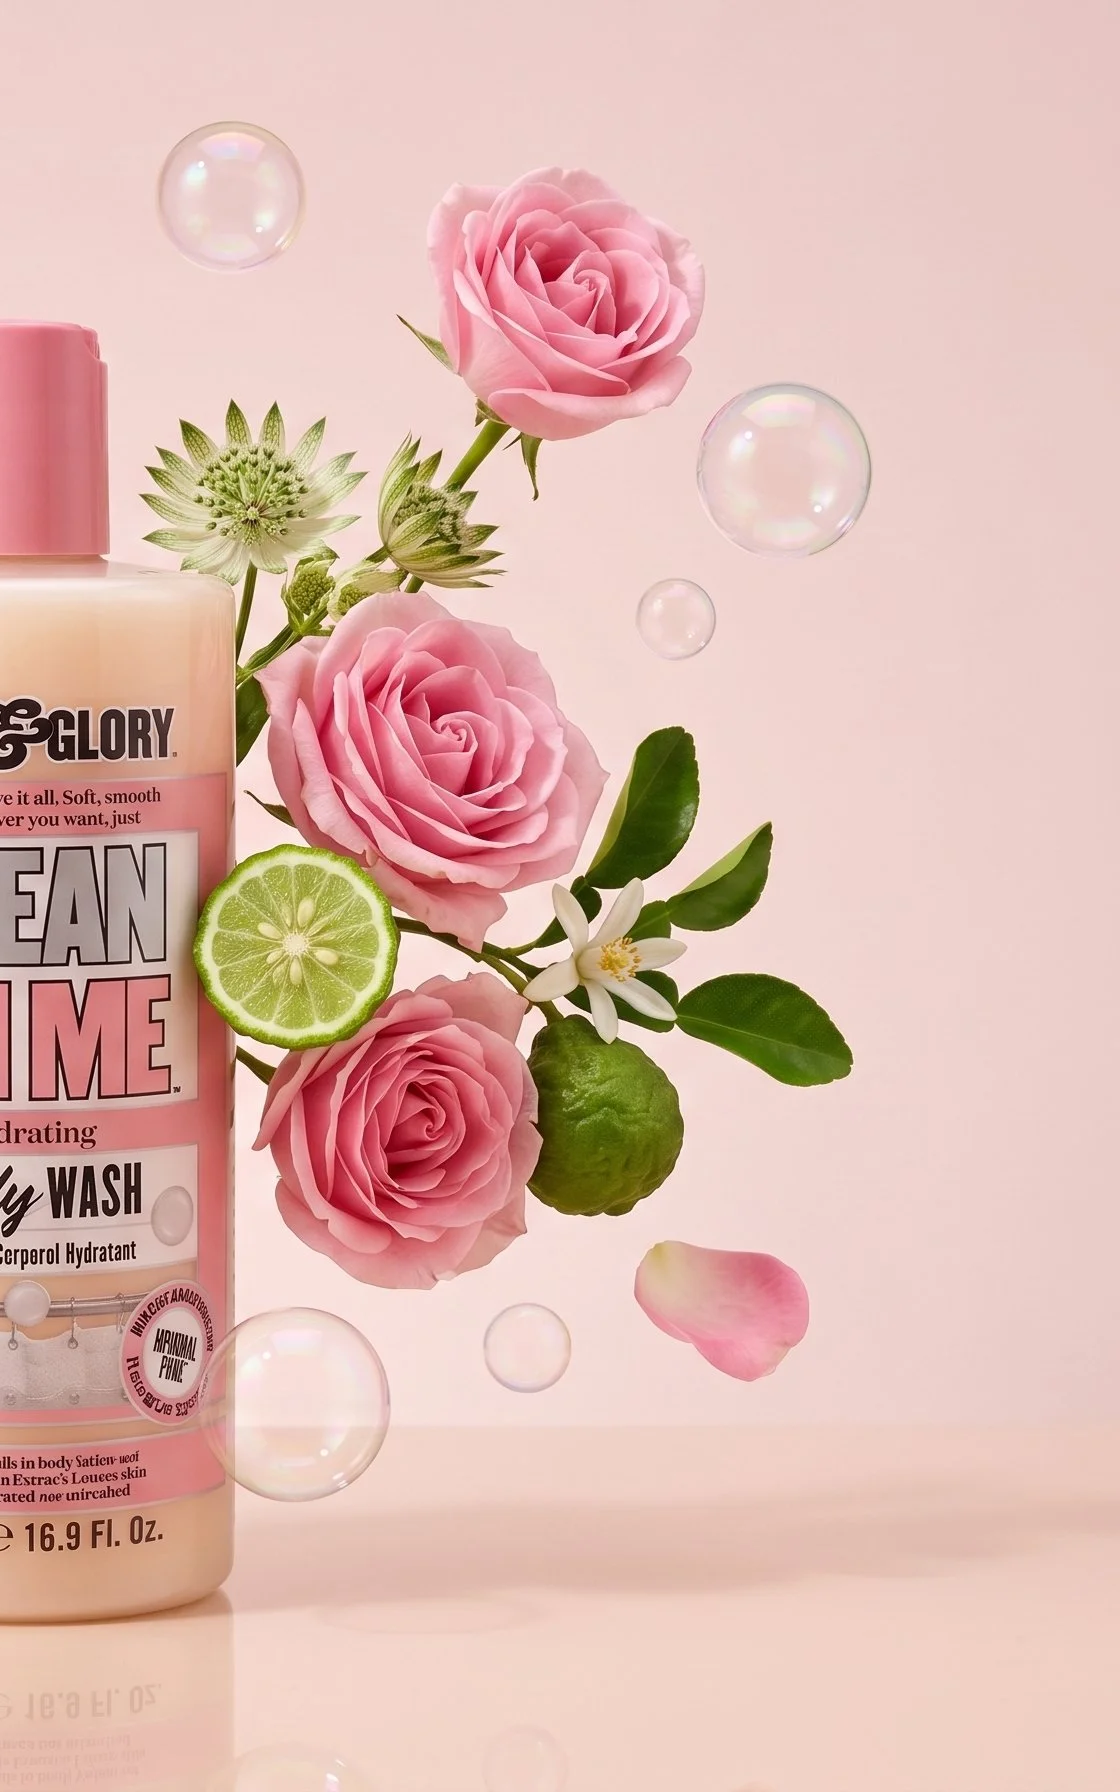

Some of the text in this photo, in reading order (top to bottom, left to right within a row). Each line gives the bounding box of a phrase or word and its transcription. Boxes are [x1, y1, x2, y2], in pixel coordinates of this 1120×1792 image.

[17, 790, 30, 805] it
[33, 789, 59, 807] all,
[62, 788, 102, 806] Soft,
[104, 786, 161, 804] smooth
[27, 815, 60, 831] you
[63, 812, 109, 827] want,
[110, 810, 142, 829] just
[28, 973, 172, 1101] ME
[46, 1161, 143, 1219] WASH
[65, 1240, 137, 1269] Hydratant
[20, 1456, 35, 1470] in
[38, 1455, 73, 1471] body
[120, 1466, 147, 1480] skin
[24, 1521, 81, 1552] 16.9
[91, 1519, 121, 1549] Fl.
[129, 1516, 164, 1544] Oz.
